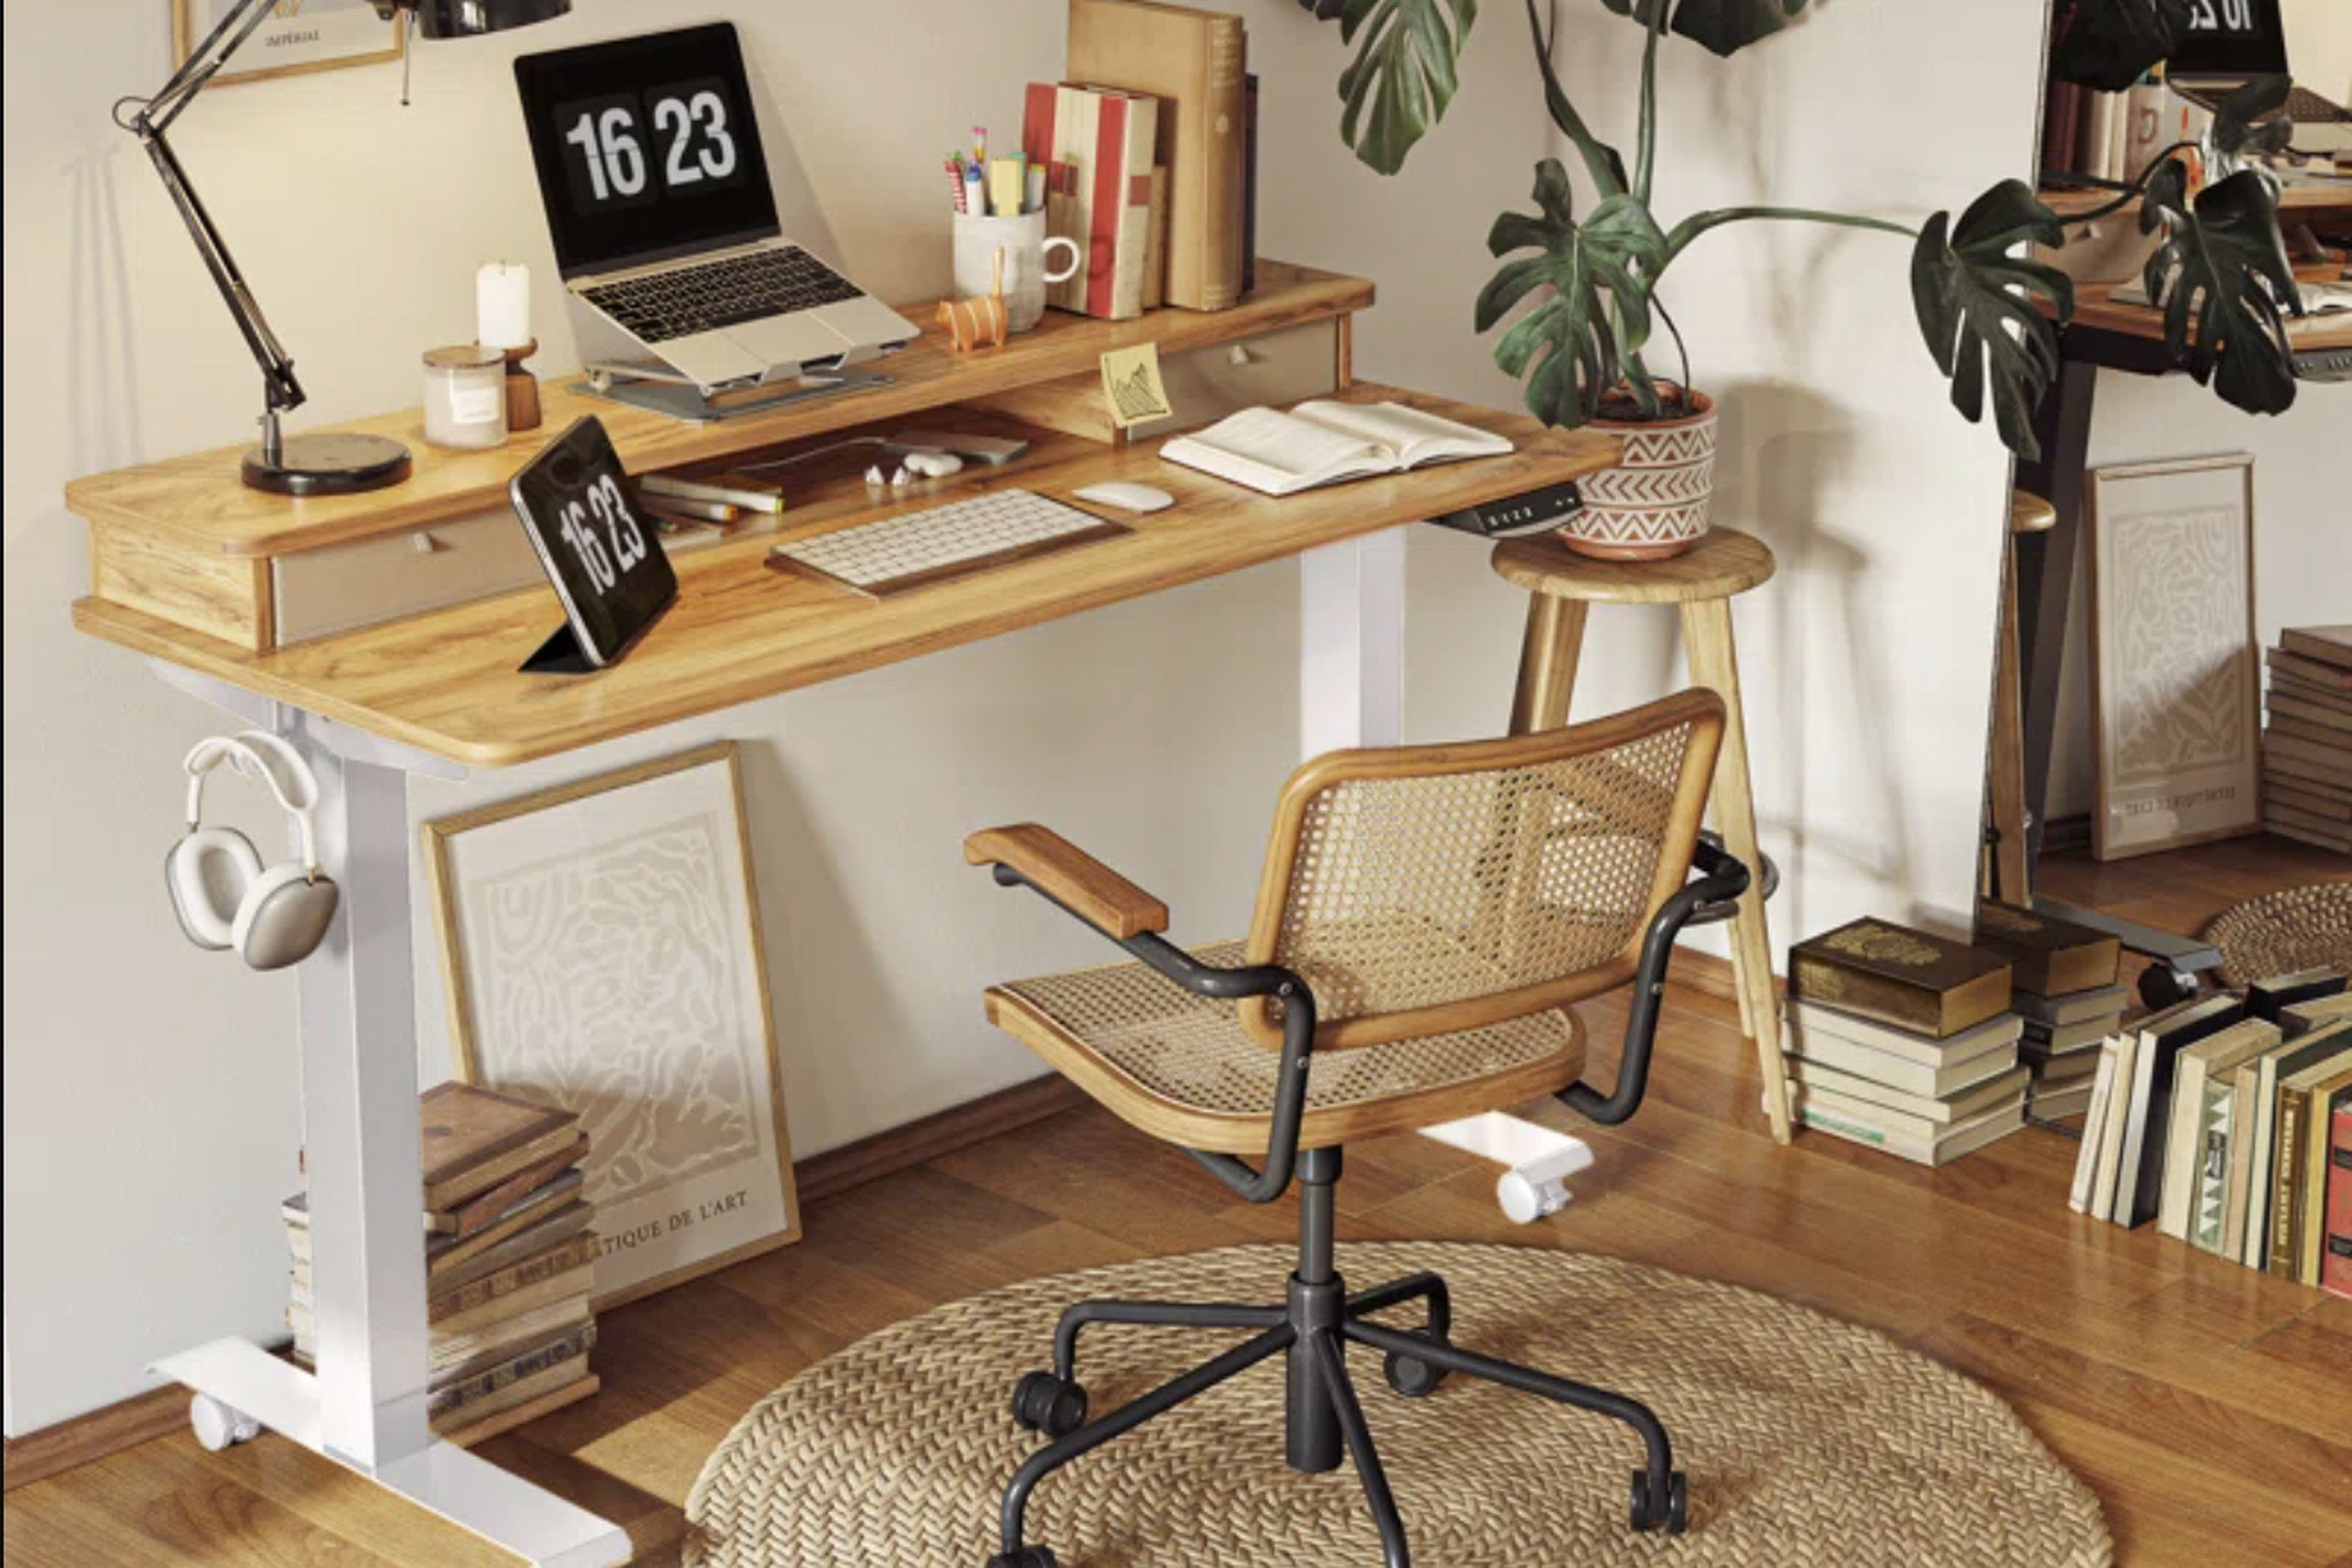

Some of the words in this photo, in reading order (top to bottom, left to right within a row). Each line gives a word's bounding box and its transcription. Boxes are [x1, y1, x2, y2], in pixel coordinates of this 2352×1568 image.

[565, 107, 647, 201] 16
[654, 90, 736, 186] 23
[559, 500, 615, 597] 16
[587, 473, 646, 573] 23
[602, 1220, 662, 1255] TIQUE
[668, 1209, 694, 1232] DE
[699, 1189, 748, 1221] L'ART
